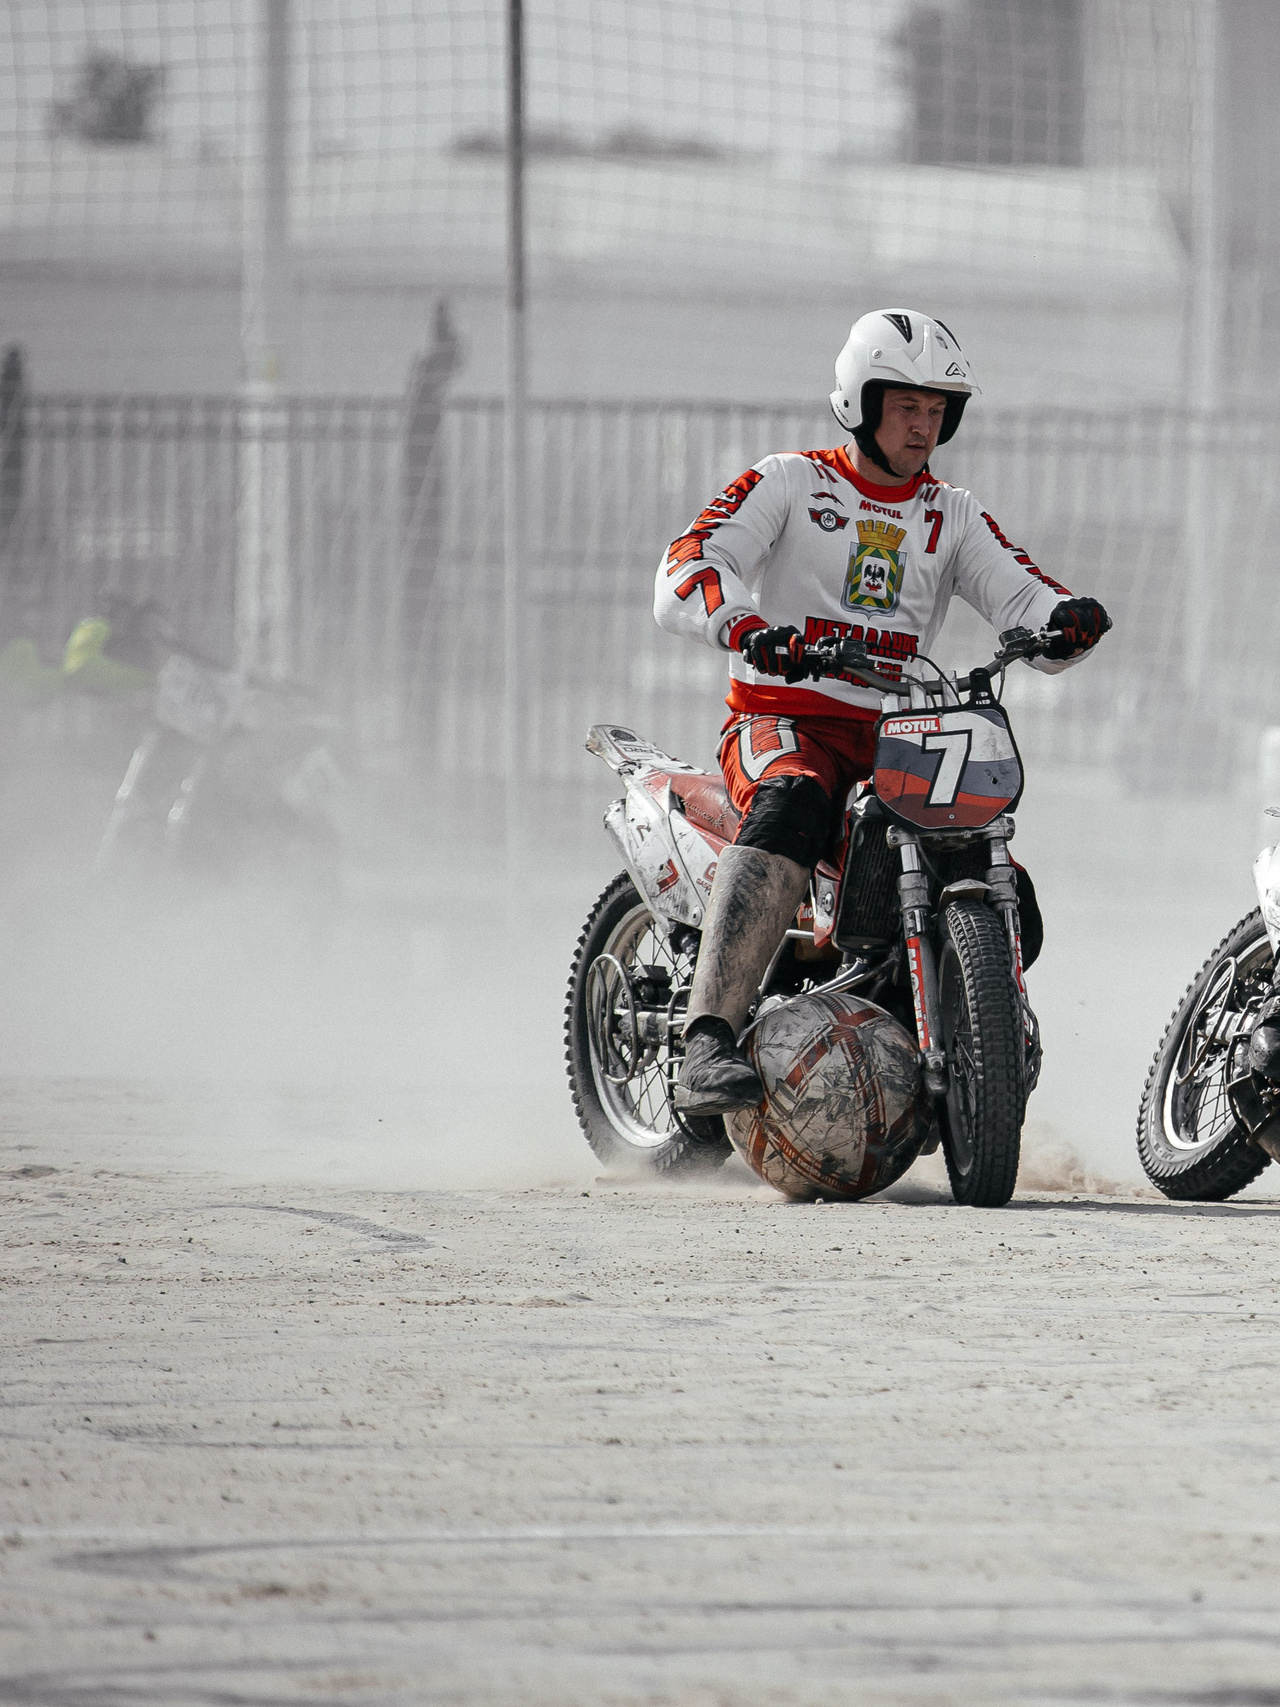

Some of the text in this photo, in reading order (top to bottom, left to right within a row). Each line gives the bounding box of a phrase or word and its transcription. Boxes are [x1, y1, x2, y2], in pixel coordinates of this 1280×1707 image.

[859, 500, 903, 520] MOTUL
[924, 508, 944, 554] 7
[674, 566, 725, 618] 7
[887, 719, 938, 734] MOTUL
[922, 729, 972, 808] 7
